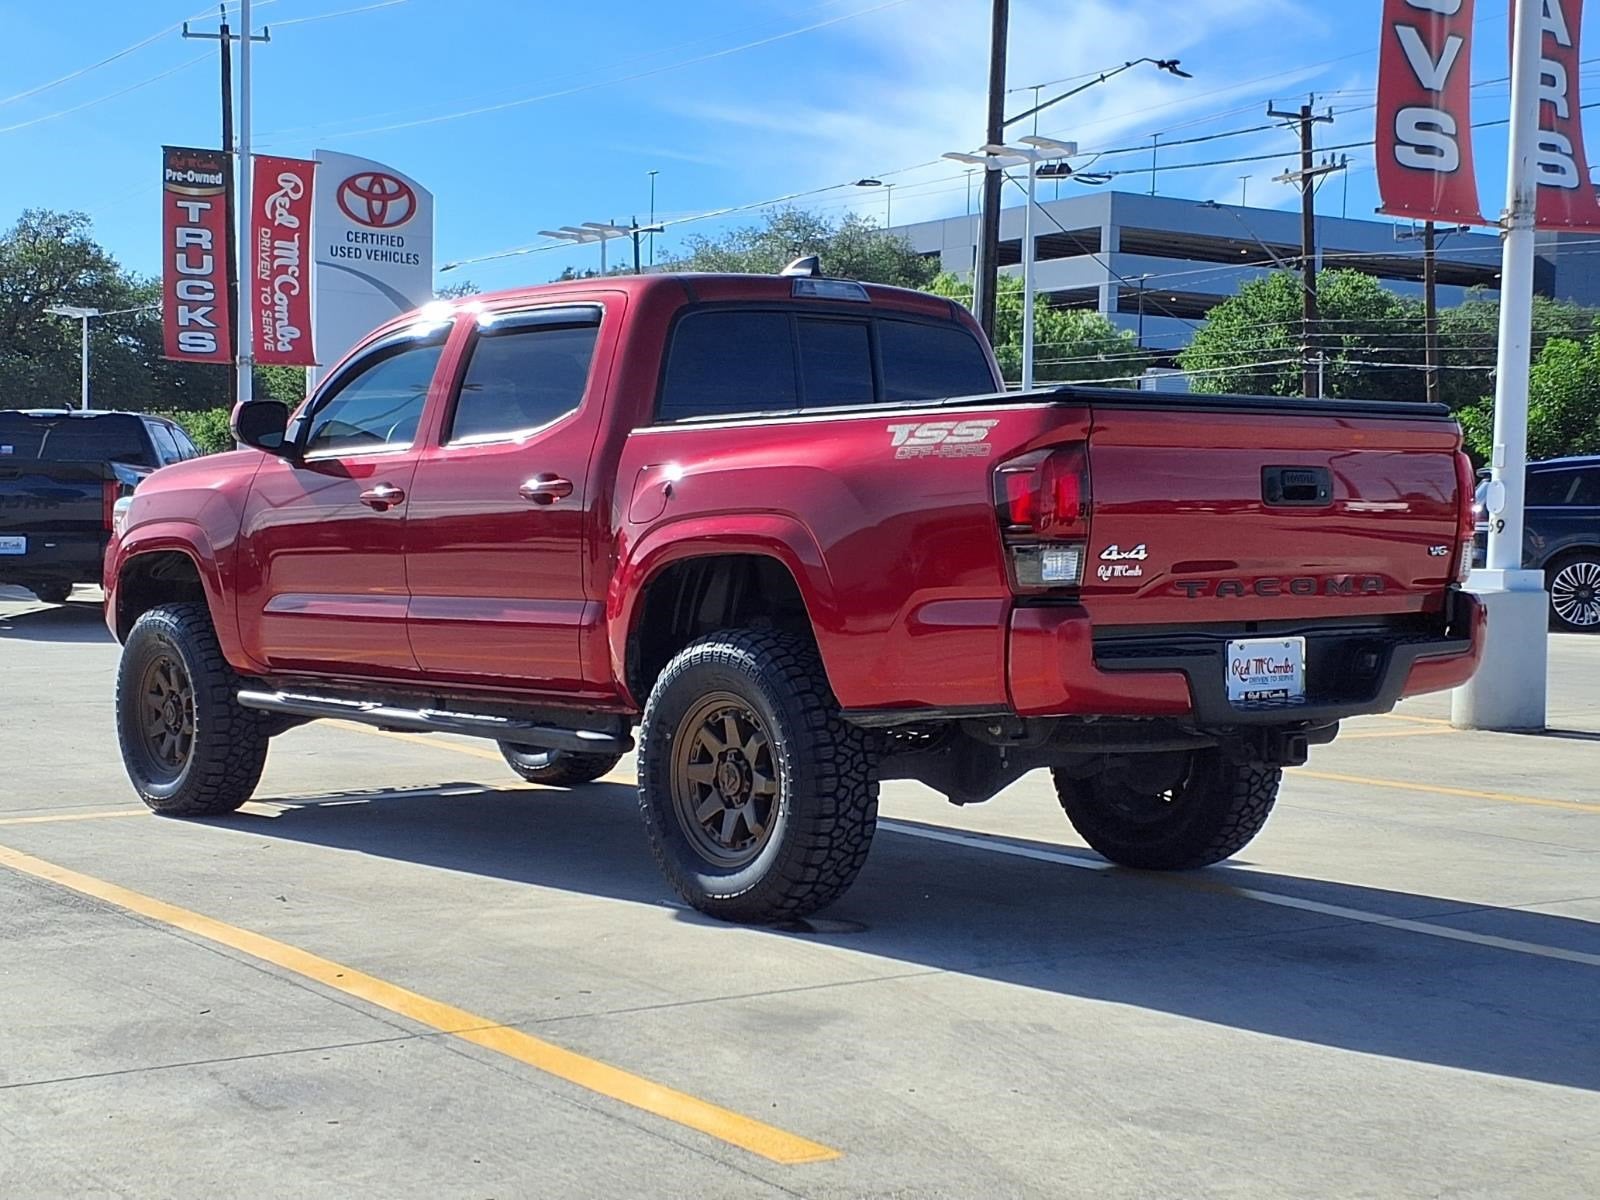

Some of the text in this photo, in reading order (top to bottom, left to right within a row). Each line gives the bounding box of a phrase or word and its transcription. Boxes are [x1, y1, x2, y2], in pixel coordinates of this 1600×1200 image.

[1395, 0, 1464, 172] VS
[165, 168, 223, 185] Pre-Owned
[346, 230, 405, 248] CERTIFIED
[264, 172, 304, 352] Red McCombs
[330, 245, 420, 266] USED VEHICLES
[175, 200, 217, 353] TRUCKS
[261, 227, 275, 351] DRIVEN TO SERVE
[886, 419, 1000, 447] TSS
[1099, 544, 1148, 560] 4x4
[1429, 545, 1449, 556] V6
[1175, 575, 1384, 599] TACOMA
[1232, 658, 1250, 682] Red
